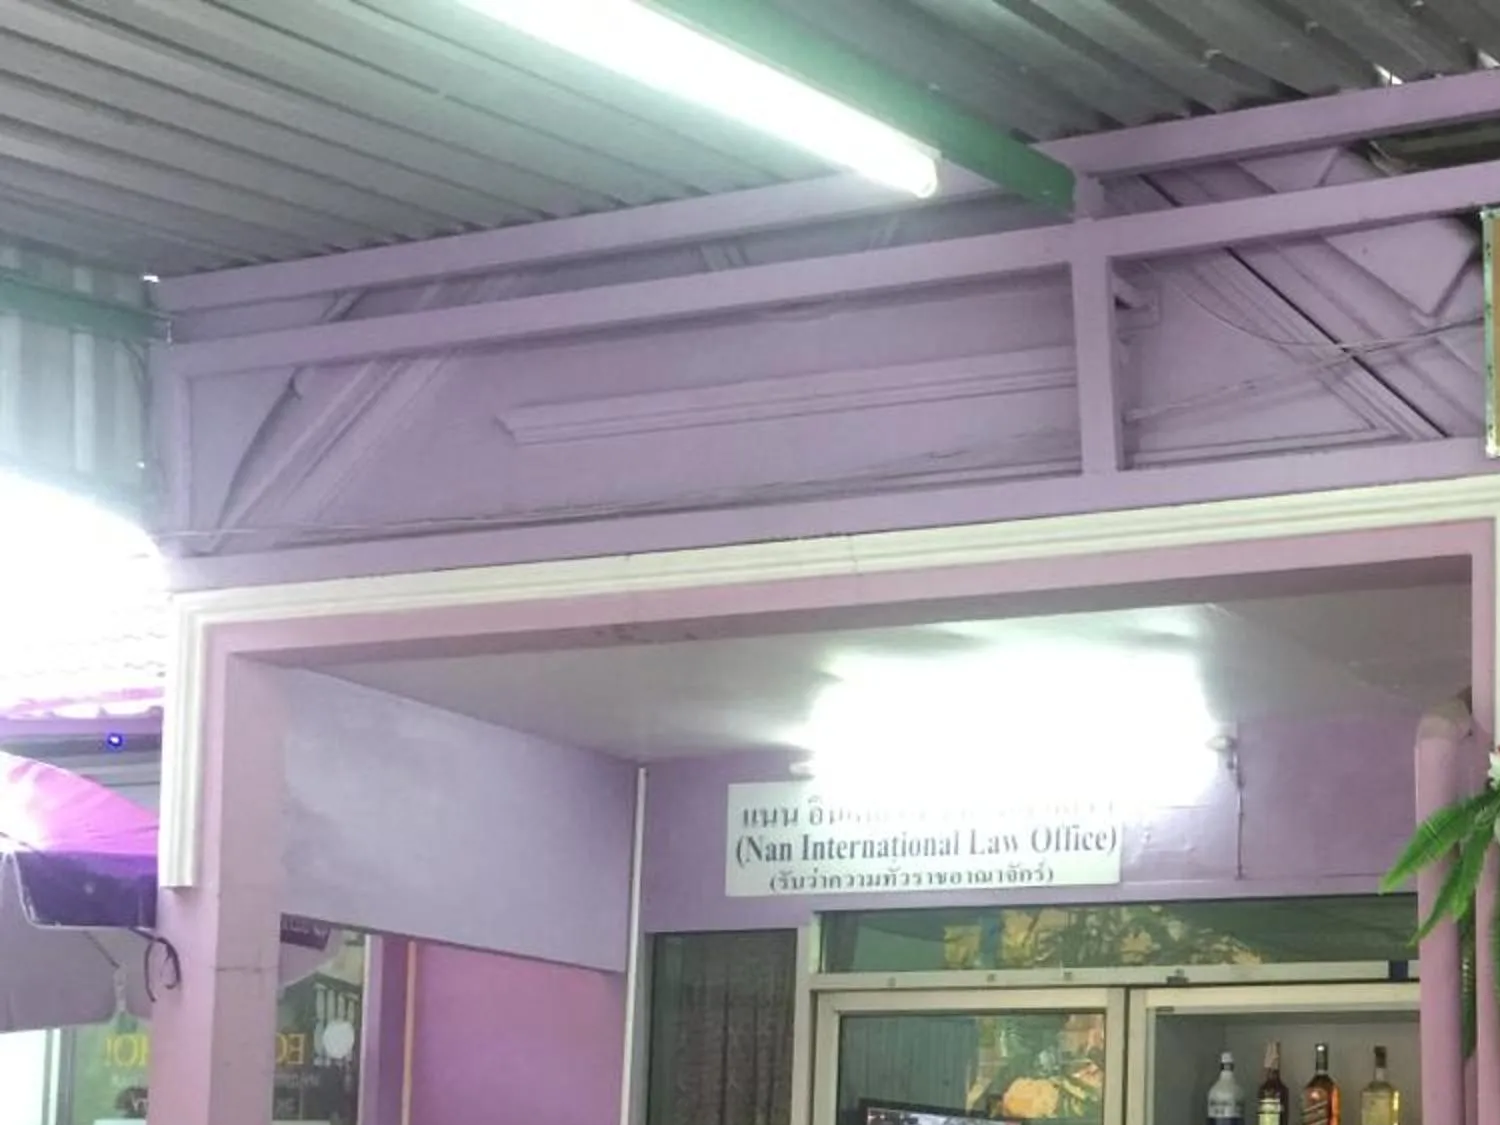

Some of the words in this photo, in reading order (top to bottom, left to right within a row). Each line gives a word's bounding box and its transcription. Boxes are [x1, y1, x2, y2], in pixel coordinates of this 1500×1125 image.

[735, 832, 793, 867] (Nan
[802, 827, 961, 862] International
[969, 829, 1020, 855] Law
[1030, 823, 1118, 855] Office)
